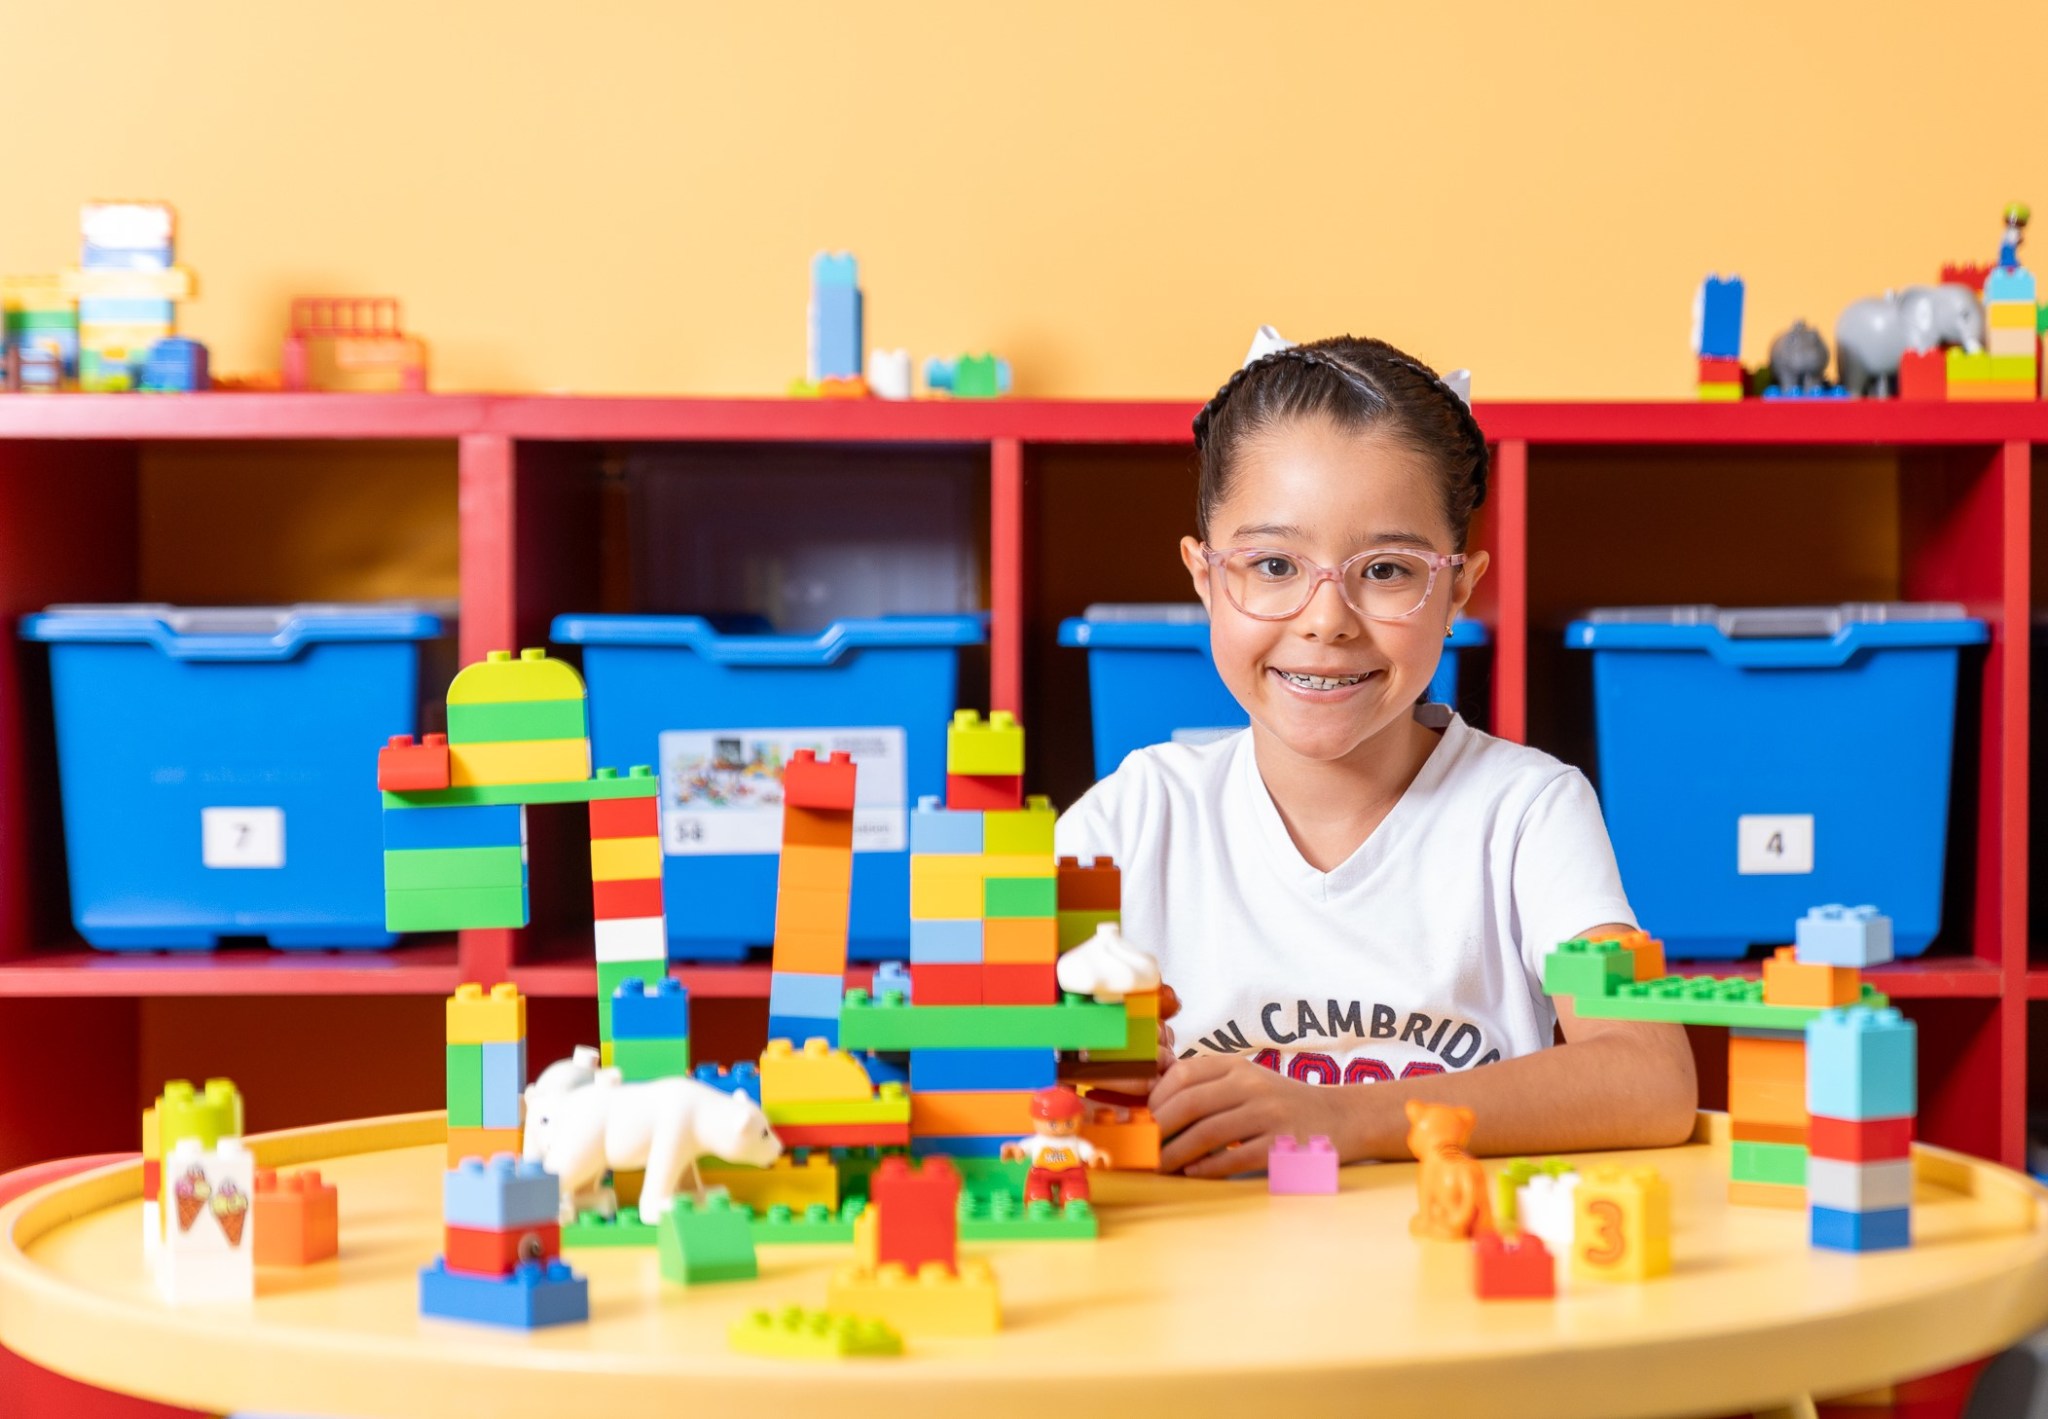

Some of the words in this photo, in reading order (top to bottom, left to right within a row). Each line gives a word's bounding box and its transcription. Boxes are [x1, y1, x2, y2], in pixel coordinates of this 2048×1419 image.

[232, 821, 251, 850] 7
[1766, 832, 1784, 855] 4
[1585, 1199, 1626, 1266] 3
